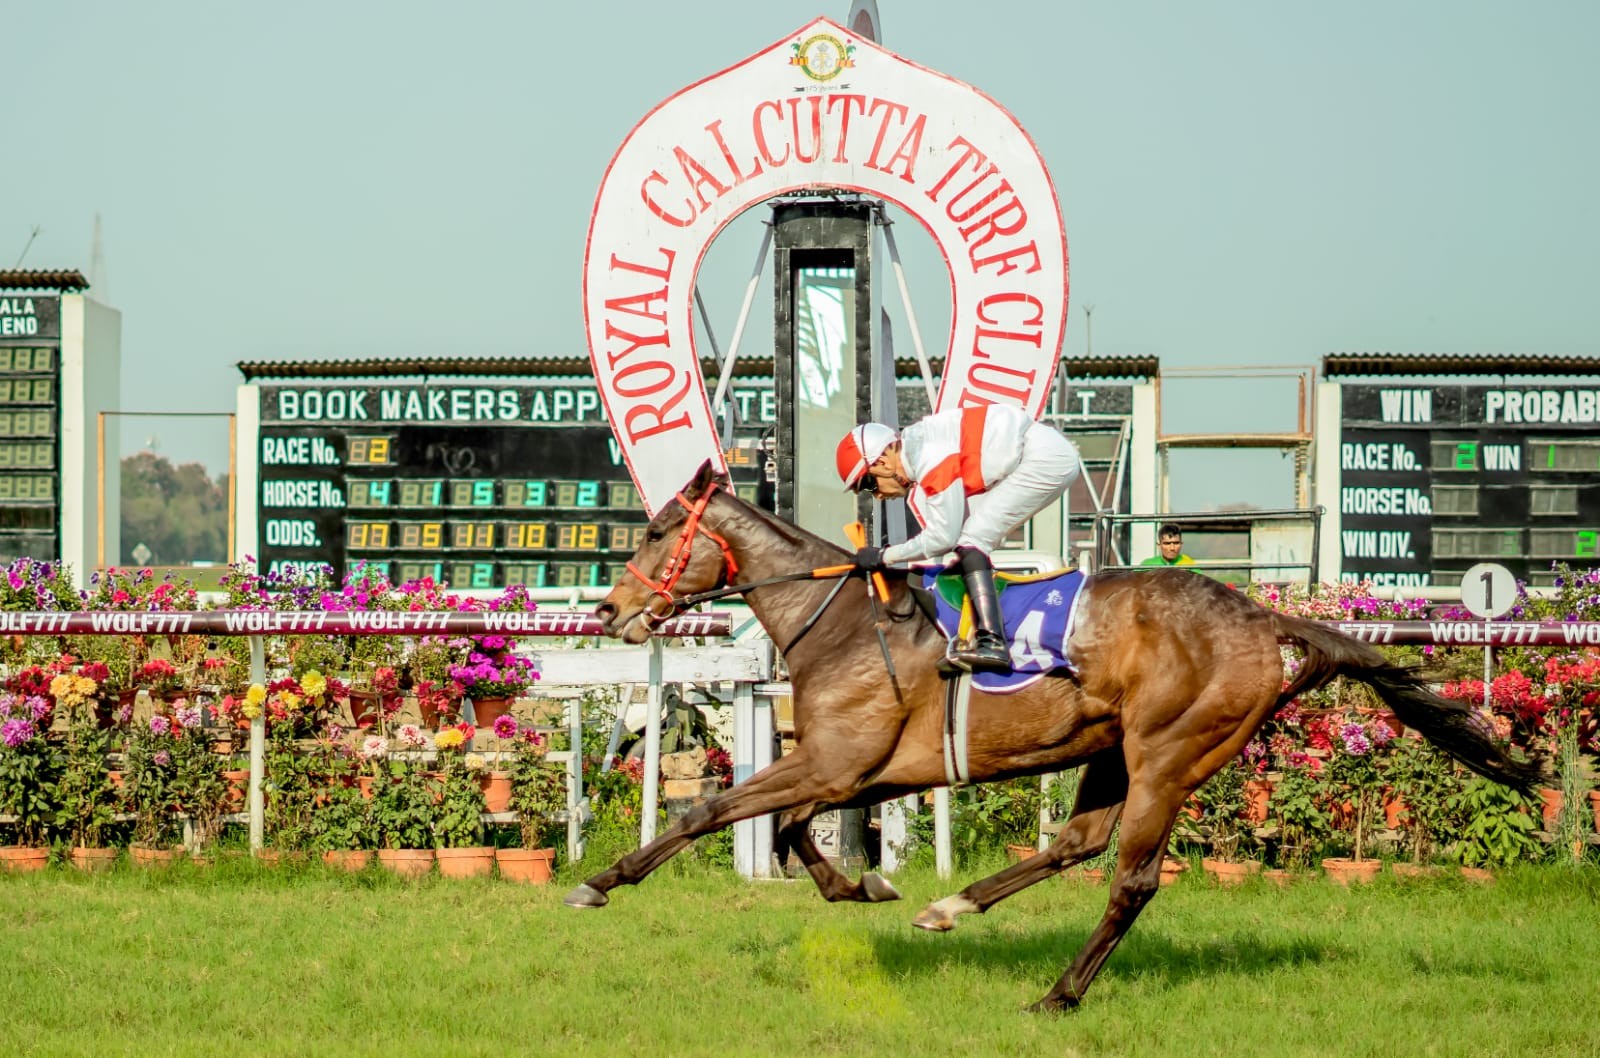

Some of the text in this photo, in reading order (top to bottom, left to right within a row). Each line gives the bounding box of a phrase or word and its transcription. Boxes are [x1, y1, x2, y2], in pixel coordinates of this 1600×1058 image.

[640, 94, 928, 228] CALCUTTA
[925, 135, 1042, 275] TURF
[0, 316, 38, 335] END
[604, 245, 693, 447] ROYAL
[279, 390, 368, 420] BOOK
[381, 390, 520, 420] MAKERS
[1381, 390, 1600, 423] WIN PROBAB
[263, 438, 341, 464] RACE No.
[368, 438, 389, 463] 2
[1342, 443, 1422, 471] RACE No.
[1456, 443, 1477, 469] 2
[1483, 445, 1520, 470] WIN
[1547, 444, 1556, 468] 1
[263, 481, 346, 507] HORSE No.
[370, 482, 599, 506] 4 1 5 3 2
[1342, 488, 1432, 515] HORSE No.
[266, 520, 321, 546] ODDS.
[360, 524, 389, 547] 17
[422, 524, 441, 547] 5
[518, 524, 545, 547] 10
[569, 524, 599, 548] 12
[1342, 530, 1415, 558] WIN DIV.
[1576, 531, 1598, 556] 2
[473, 563, 493, 587] 2
[1478, 571, 1493, 611] 1
[91, 613, 193, 633] WOLF777
[224, 611, 328, 632] WOLF777
[348, 611, 451, 631] WOLF777
[484, 612, 588, 632] WOLF777
[1327, 623, 1395, 643] F777
[1429, 622, 1540, 644] WOLF777
[1009, 610, 1054, 670] 4
